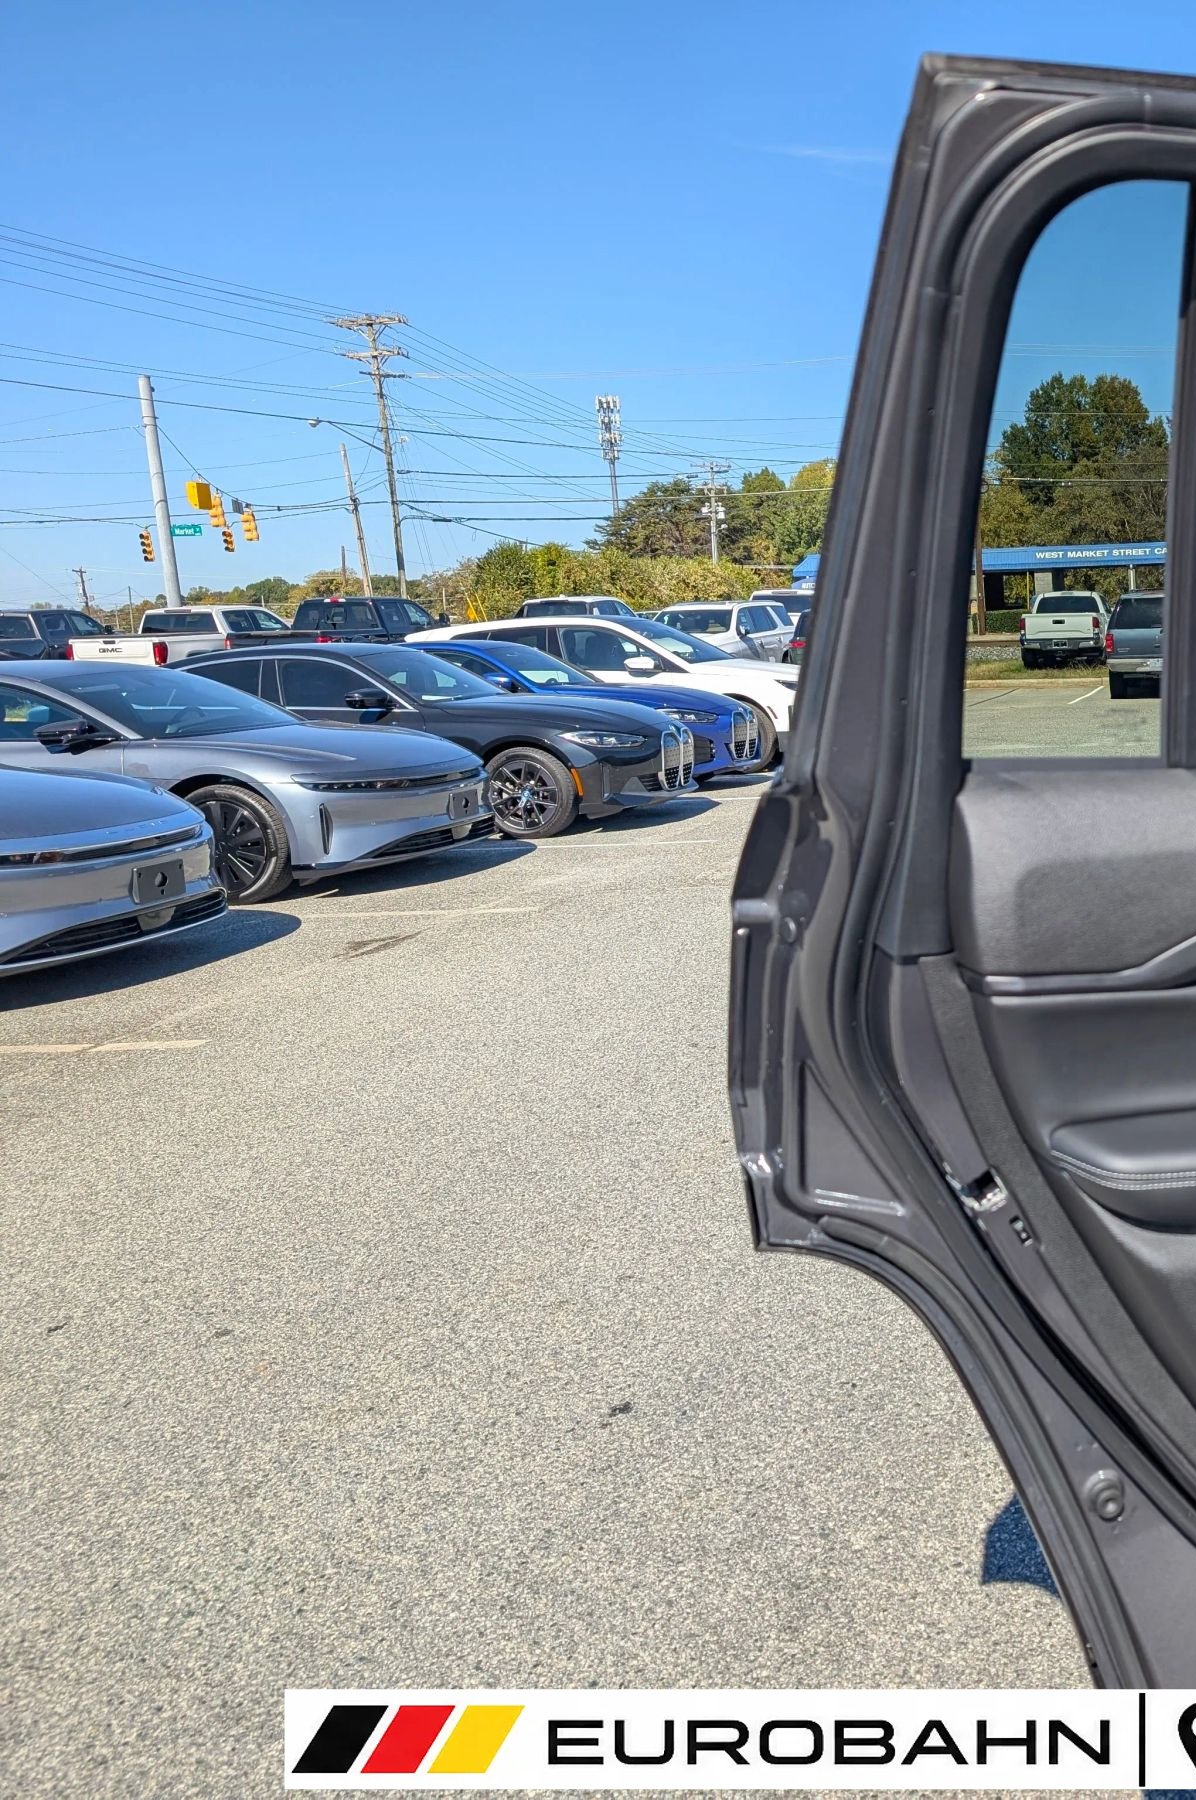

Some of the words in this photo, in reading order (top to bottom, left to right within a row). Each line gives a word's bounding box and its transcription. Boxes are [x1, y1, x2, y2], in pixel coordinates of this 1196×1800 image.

[1035, 551, 1064, 559] WEST
[1067, 549, 1109, 558] MARKET
[1112, 548, 1151, 557] STREET
